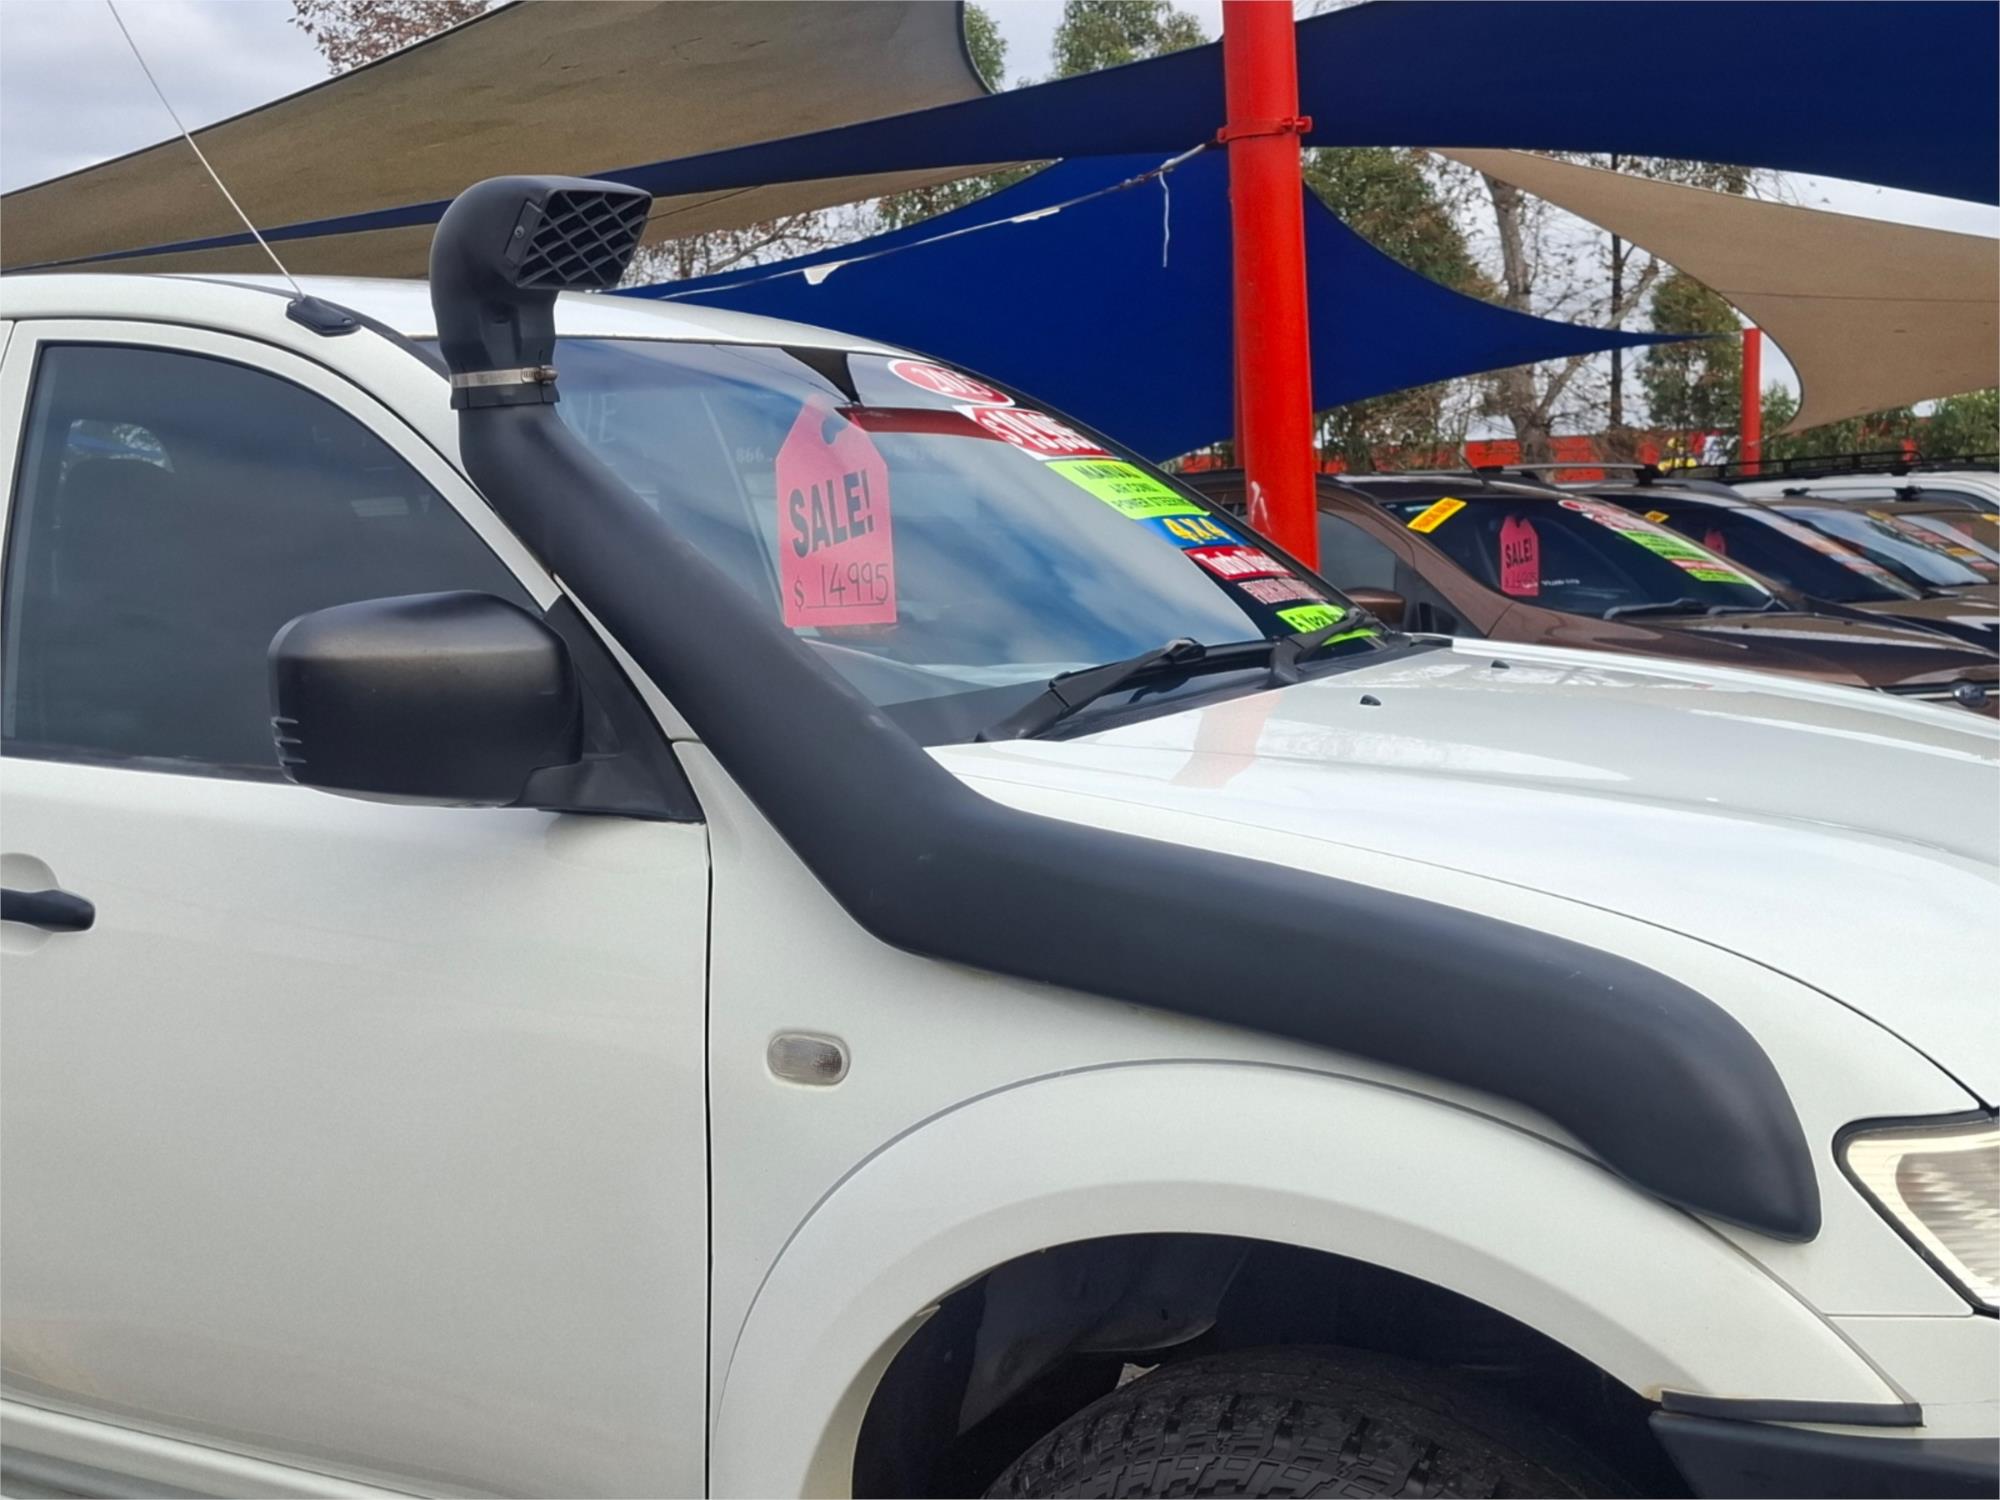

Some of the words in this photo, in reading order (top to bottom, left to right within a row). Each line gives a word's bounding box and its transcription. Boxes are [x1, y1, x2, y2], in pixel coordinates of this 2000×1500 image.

[789, 469, 875, 558] SALE!
[1505, 537, 1532, 568] SALE!
[794, 576, 804, 612] $
[820, 563, 889, 608] 14995
